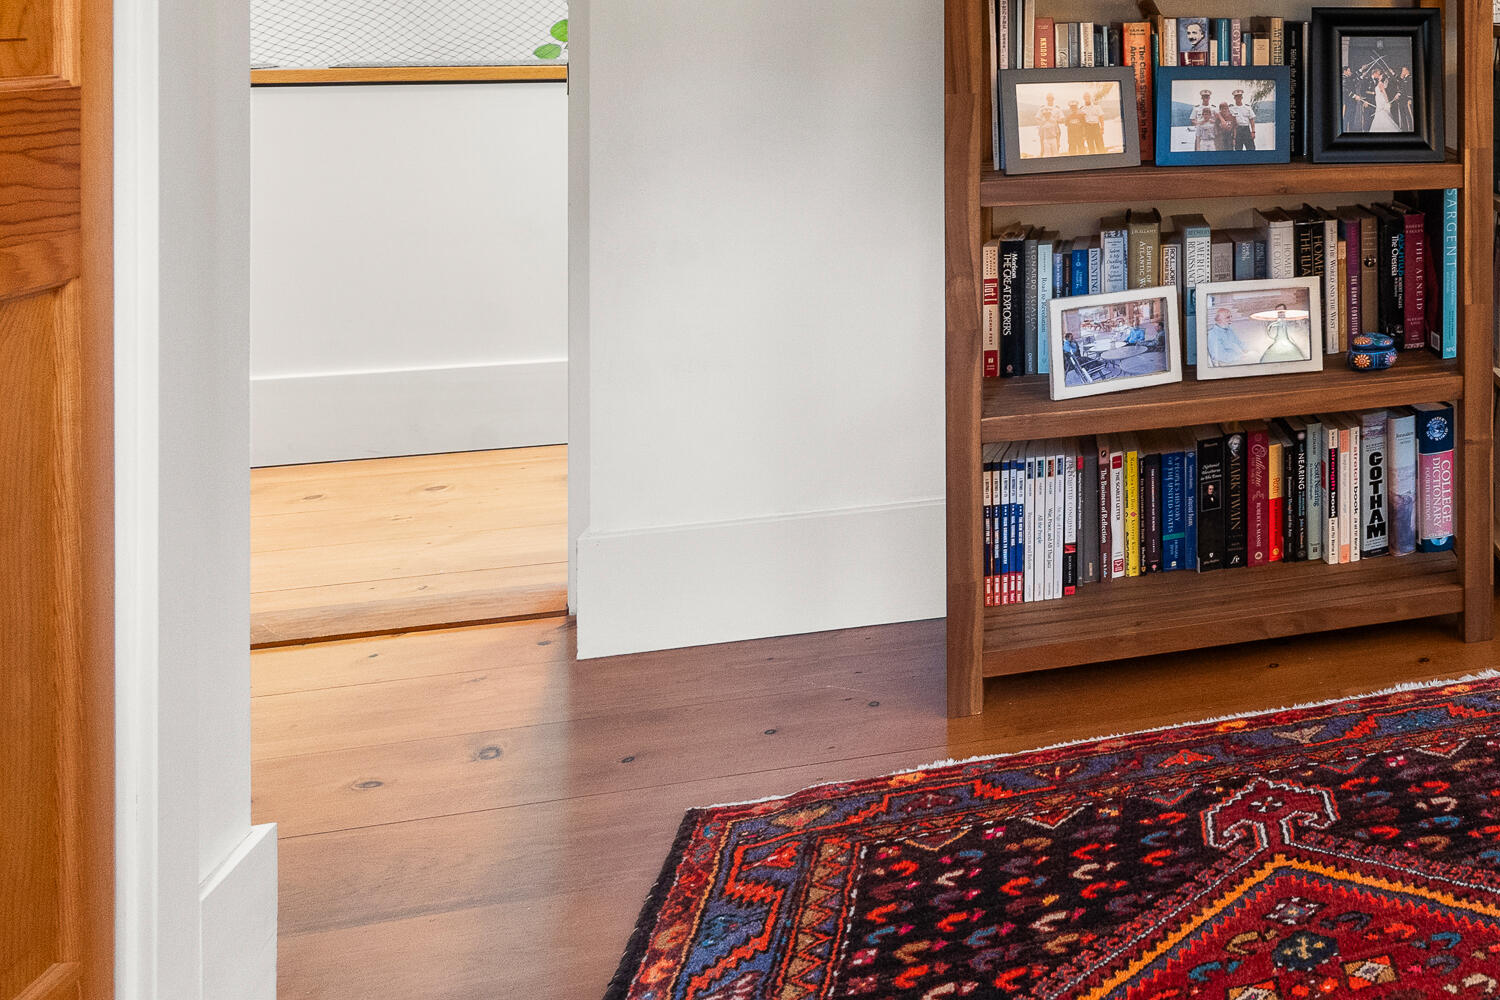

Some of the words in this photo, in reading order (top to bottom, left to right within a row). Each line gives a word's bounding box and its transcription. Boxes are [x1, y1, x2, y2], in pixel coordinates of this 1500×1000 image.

[1138, 85, 1146, 118] Struggle
[1446, 189, 1457, 268] SARGENT
[1003, 254, 1011, 267] THE
[1090, 249, 1098, 292] INVENTING
[1003, 269, 1011, 294] GREAT
[1003, 296, 1011, 336] EXPLORERS
[1231, 456, 1241, 489] MARK
[1442, 458, 1451, 523] COLLEGE
[1231, 492, 1241, 530] TWAIN
[1366, 452, 1385, 538] GOTHAM
[1432, 458, 1442, 528] DICTIONARY
